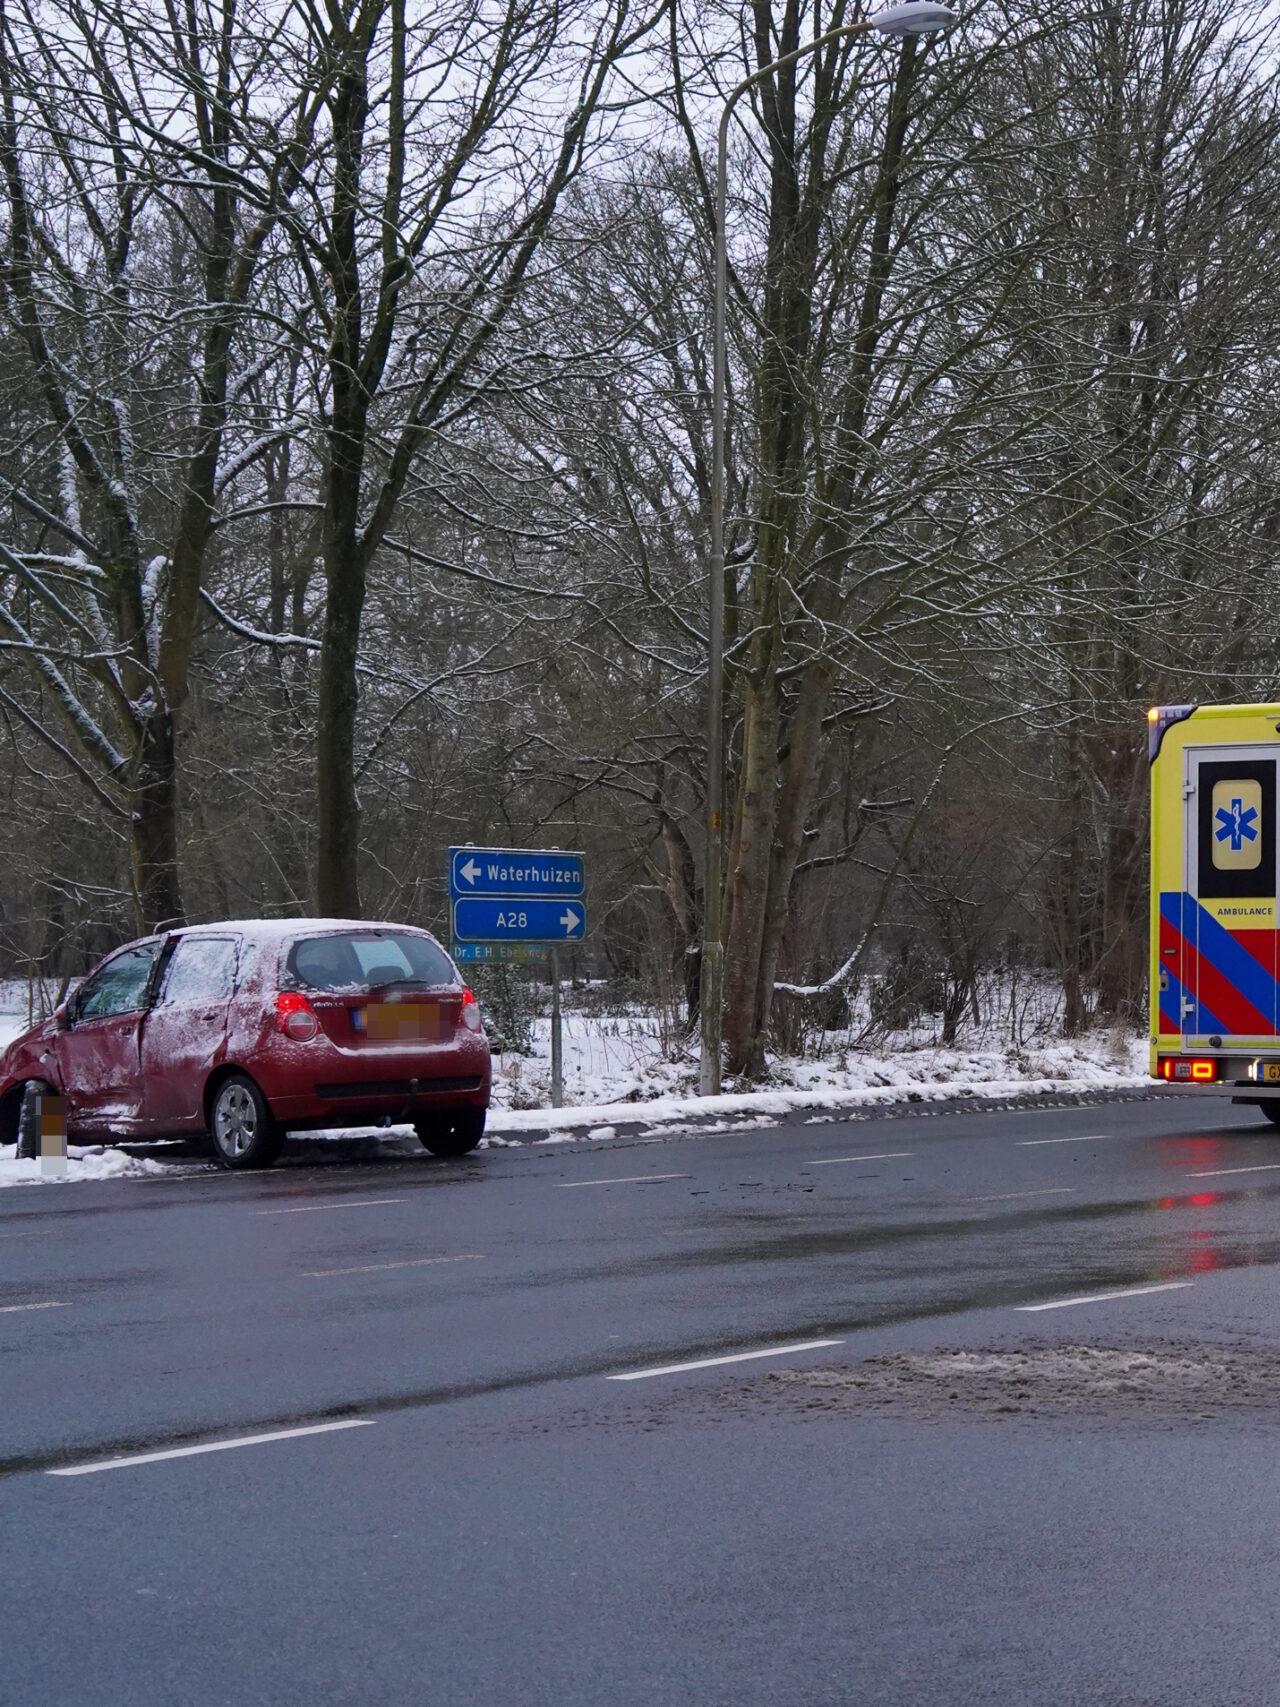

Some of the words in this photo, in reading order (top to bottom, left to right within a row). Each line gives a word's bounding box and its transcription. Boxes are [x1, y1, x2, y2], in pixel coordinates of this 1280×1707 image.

[487, 864, 580, 883] Waterhuizen
[1217, 907, 1273, 916] AMBULANCE
[496, 912, 528, 928] A28
[454, 947, 470, 958] Dr.
